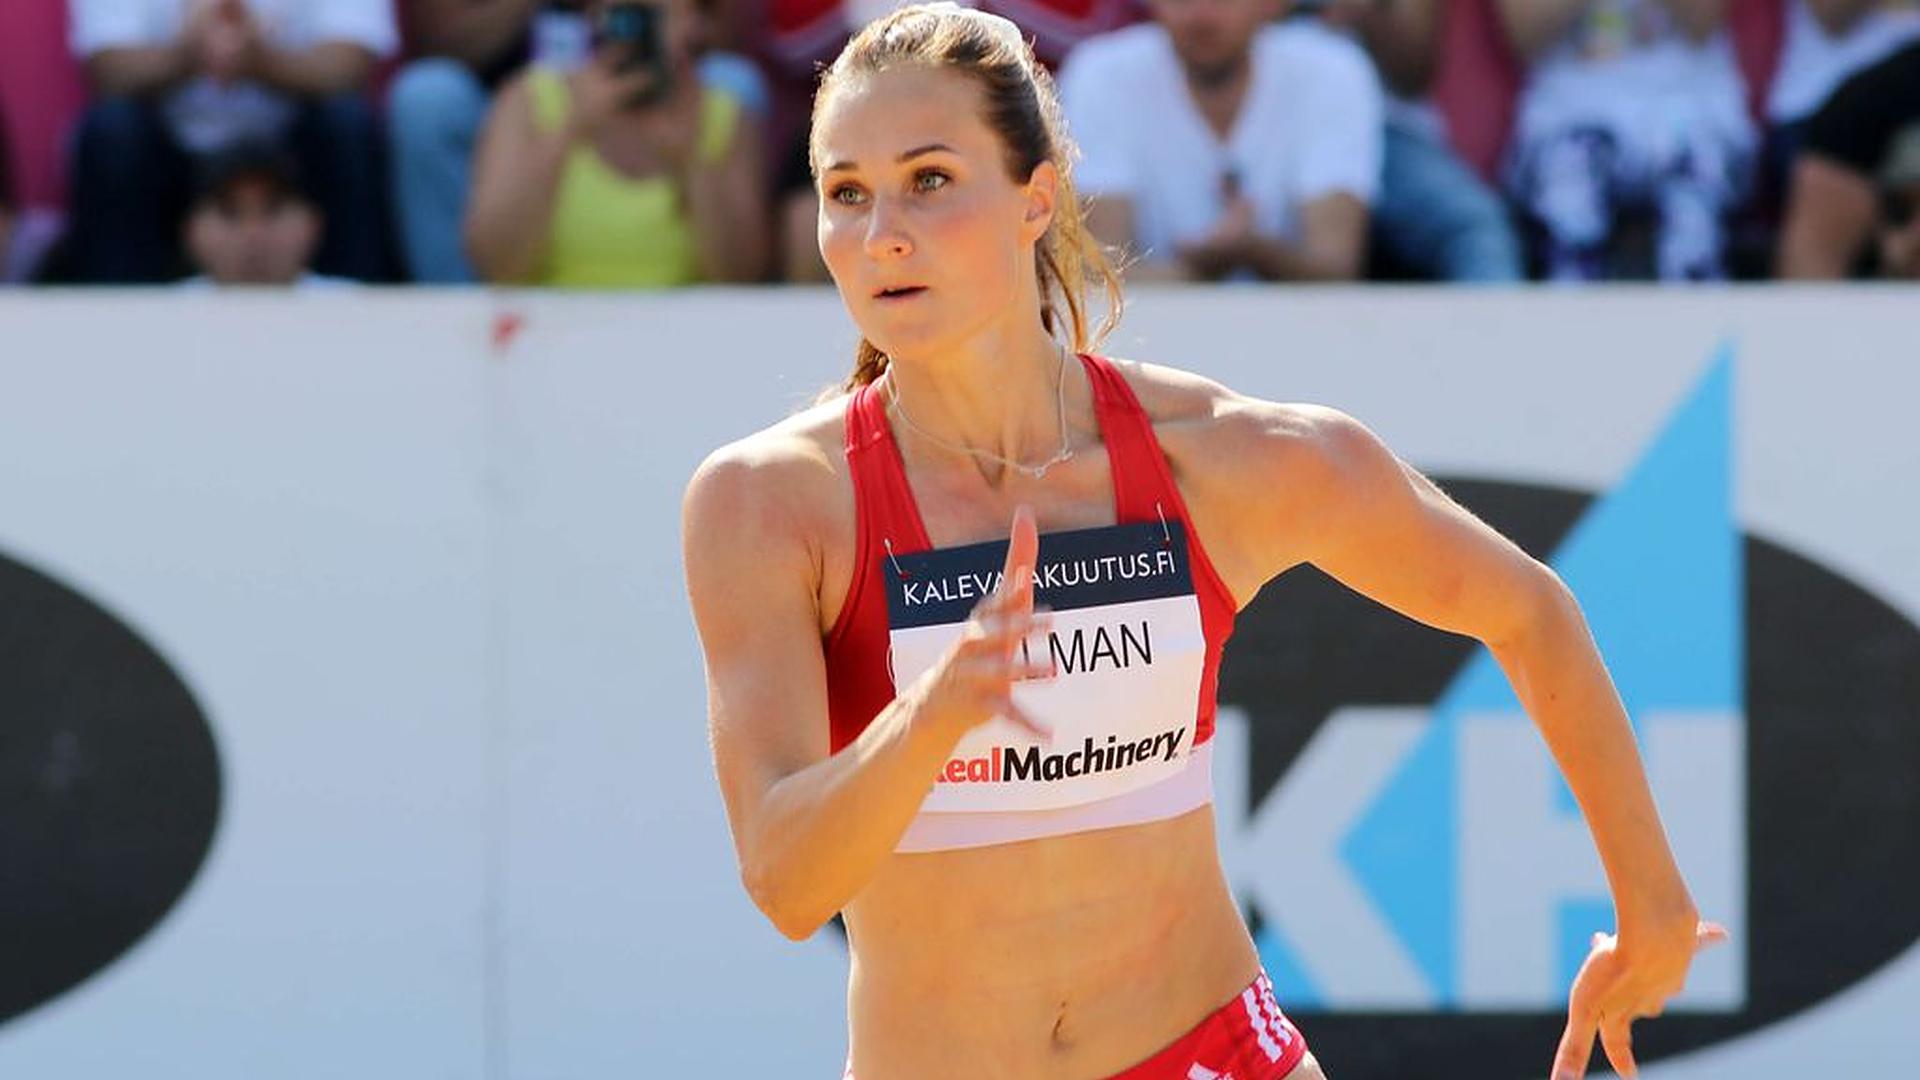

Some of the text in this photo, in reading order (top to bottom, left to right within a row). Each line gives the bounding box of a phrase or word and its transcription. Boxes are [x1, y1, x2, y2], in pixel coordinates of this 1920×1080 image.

[903, 551, 1175, 606] KALEVAAKUUTUS.FI
[936, 727, 1185, 783] ealMachinery
[1212, 705, 1746, 1012] KH
